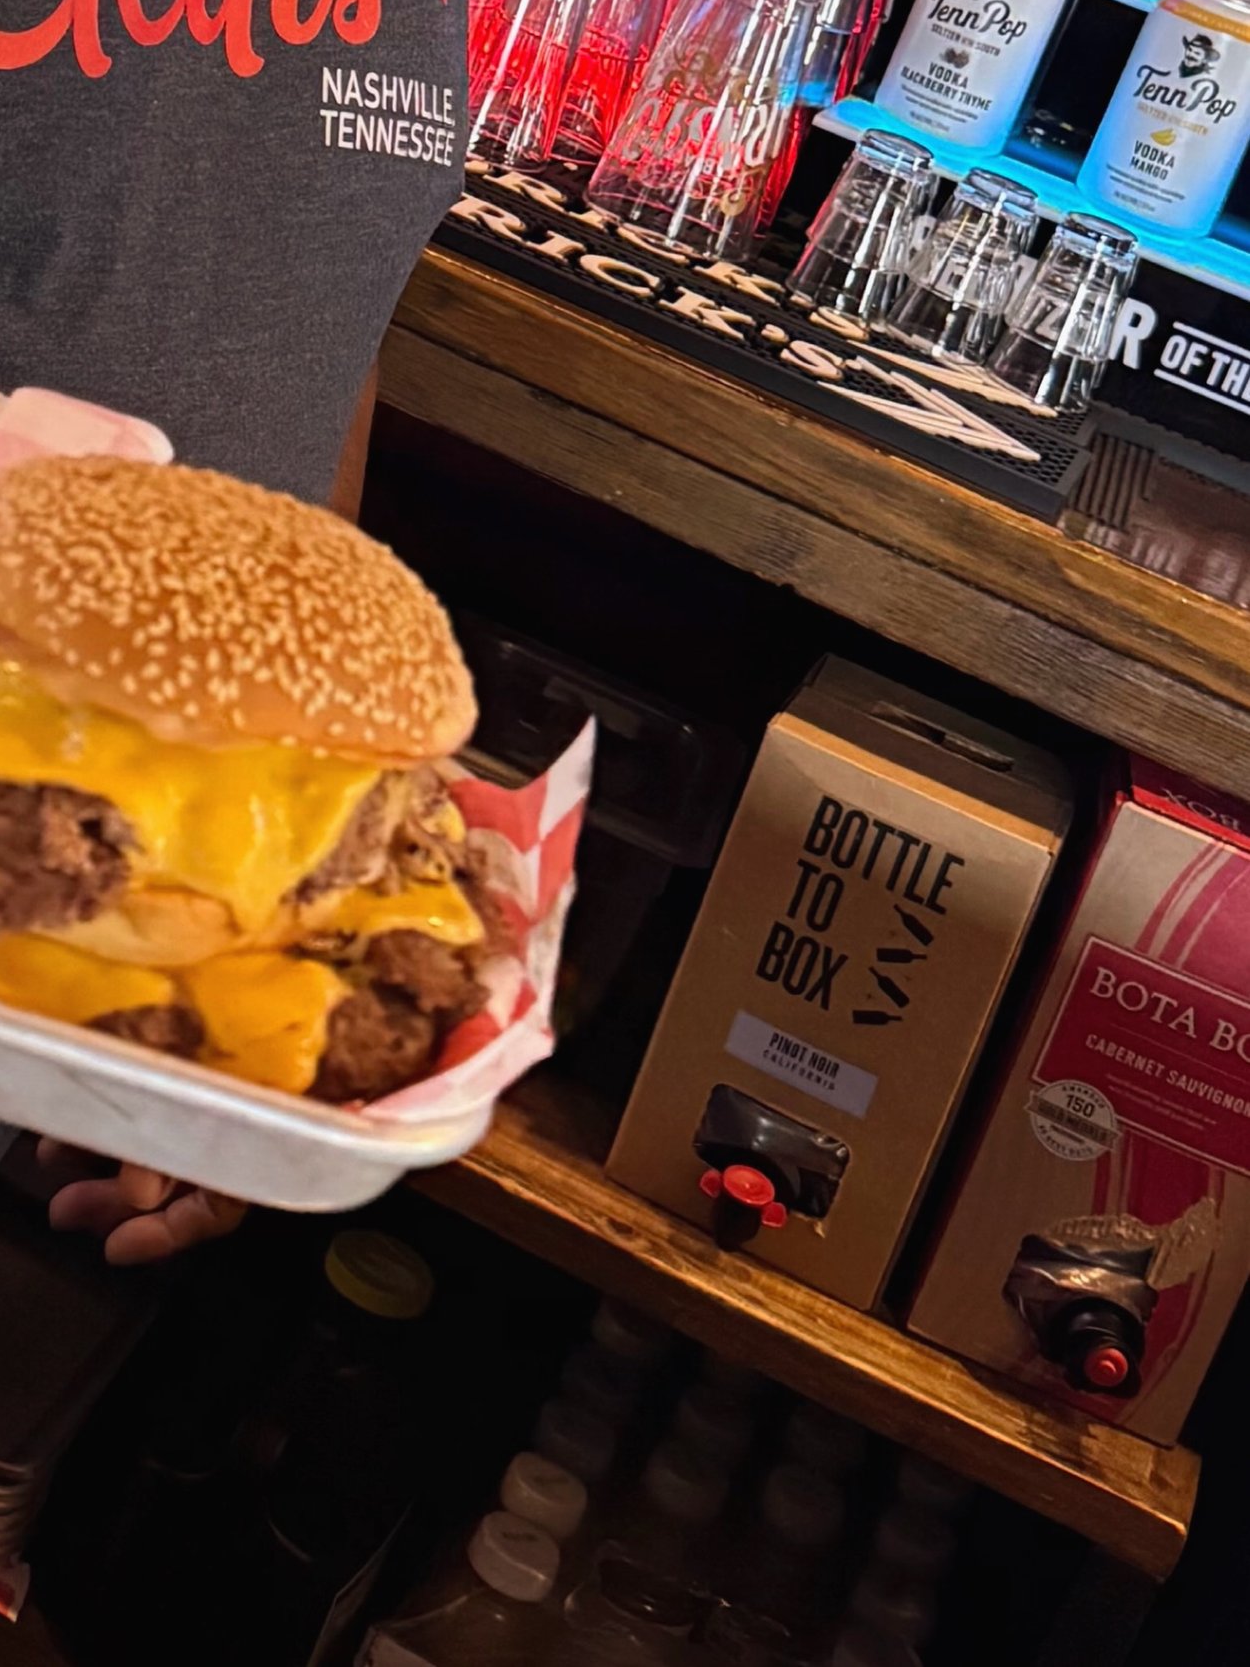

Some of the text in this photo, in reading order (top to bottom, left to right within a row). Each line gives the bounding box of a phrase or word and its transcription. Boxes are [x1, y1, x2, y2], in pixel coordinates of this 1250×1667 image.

[978, 0, 1028, 45] Pop
[322, 66, 455, 127] NASHVILLE
[901, 66, 958, 101] BLACKBERRY
[959, 91, 993, 112] THYME
[929, 62, 969, 90] VODKA
[1133, 64, 1237, 124] Tenn Pop
[319, 109, 455, 167] TENNESSEE
[1134, 140, 1176, 170] VODKA
[1130, 156, 1169, 181] MANGO
[1159, 334, 1205, 376] OF
[803, 795, 965, 916] BOTTLE
[786, 858, 845, 933] TO
[755, 921, 849, 1012] BOX
[1090, 966, 1197, 1039] BOTA
[762, 1049, 836, 1091] CALIFORNIA
[769, 1032, 840, 1080] PINOT NOIR
[1086, 1033, 1164, 1079] CABERNET
[1065, 1093, 1095, 1119] 150
